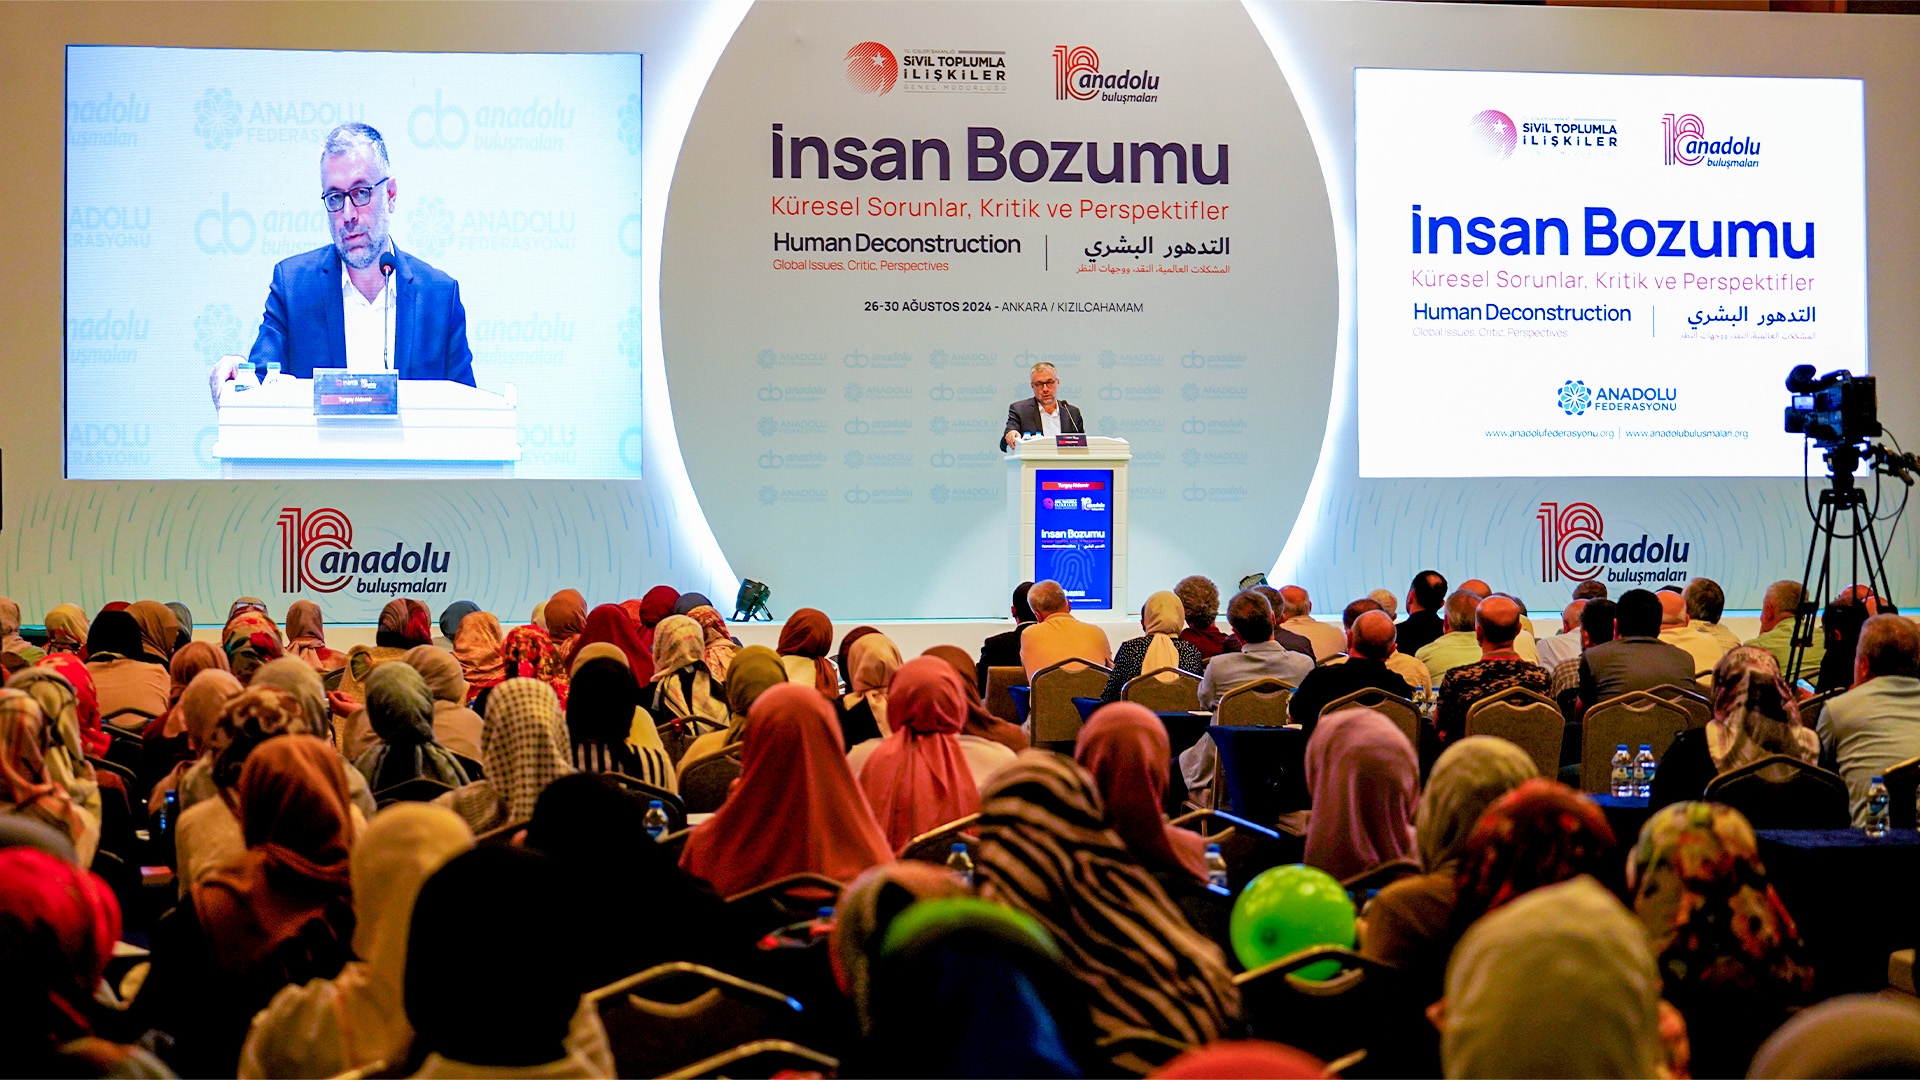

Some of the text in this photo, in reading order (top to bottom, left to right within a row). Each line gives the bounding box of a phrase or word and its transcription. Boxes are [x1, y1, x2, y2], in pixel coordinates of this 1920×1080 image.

[938, 56, 1006, 68] TOPLUMLA
[1079, 69, 1160, 91] anadolu
[1101, 91, 1158, 105] buluşmaları
[476, 98, 575, 129] anadolu
[248, 128, 329, 143] FEDERASY
[1554, 124, 1618, 135] TOPLUMLA
[967, 126, 1229, 185] Bozumu
[1686, 136, 1761, 156] anadolu
[1706, 157, 1760, 169] buluşmaları
[772, 196, 1229, 224] Küresel Sorunlar, Kritik ve Perspektifler
[460, 209, 576, 234] ANADOLU
[1584, 206, 1815, 259] Bozumu
[774, 232, 1021, 254] Human Deconstruction
[1084, 236, 1230, 263] التدهور البشري
[773, 259, 806, 271] Global
[880, 260, 949, 273] Perspectives
[1412, 270, 1489, 287] Küresel
[1596, 272, 1648, 289] Kritik
[1654, 276, 1677, 290] ve
[1684, 272, 1815, 294] Perspektifler
[864, 302, 900, 312] 26-30
[902, 300, 960, 312] AĞUSTOS
[962, 302, 992, 312] 2024
[1002, 302, 1048, 312] ANKARA
[1058, 302, 1144, 313] KIZILCAHAMAM
[1414, 303, 1631, 321] Human Deconstruction
[1688, 306, 1816, 330] التدهور البشري
[1412, 327, 1442, 337] Global
[1508, 328, 1568, 339] Perspectives
[1596, 388, 1677, 401] ANADOLU
[1595, 402, 1677, 411] FEDERASYONU
[1068, 529, 1105, 539] Bozumu
[320, 542, 451, 574] anadolu
[1574, 534, 1690, 564] anadolu
[1608, 567, 1687, 586] buluşmaları
[356, 578, 447, 597] buluşmaları
